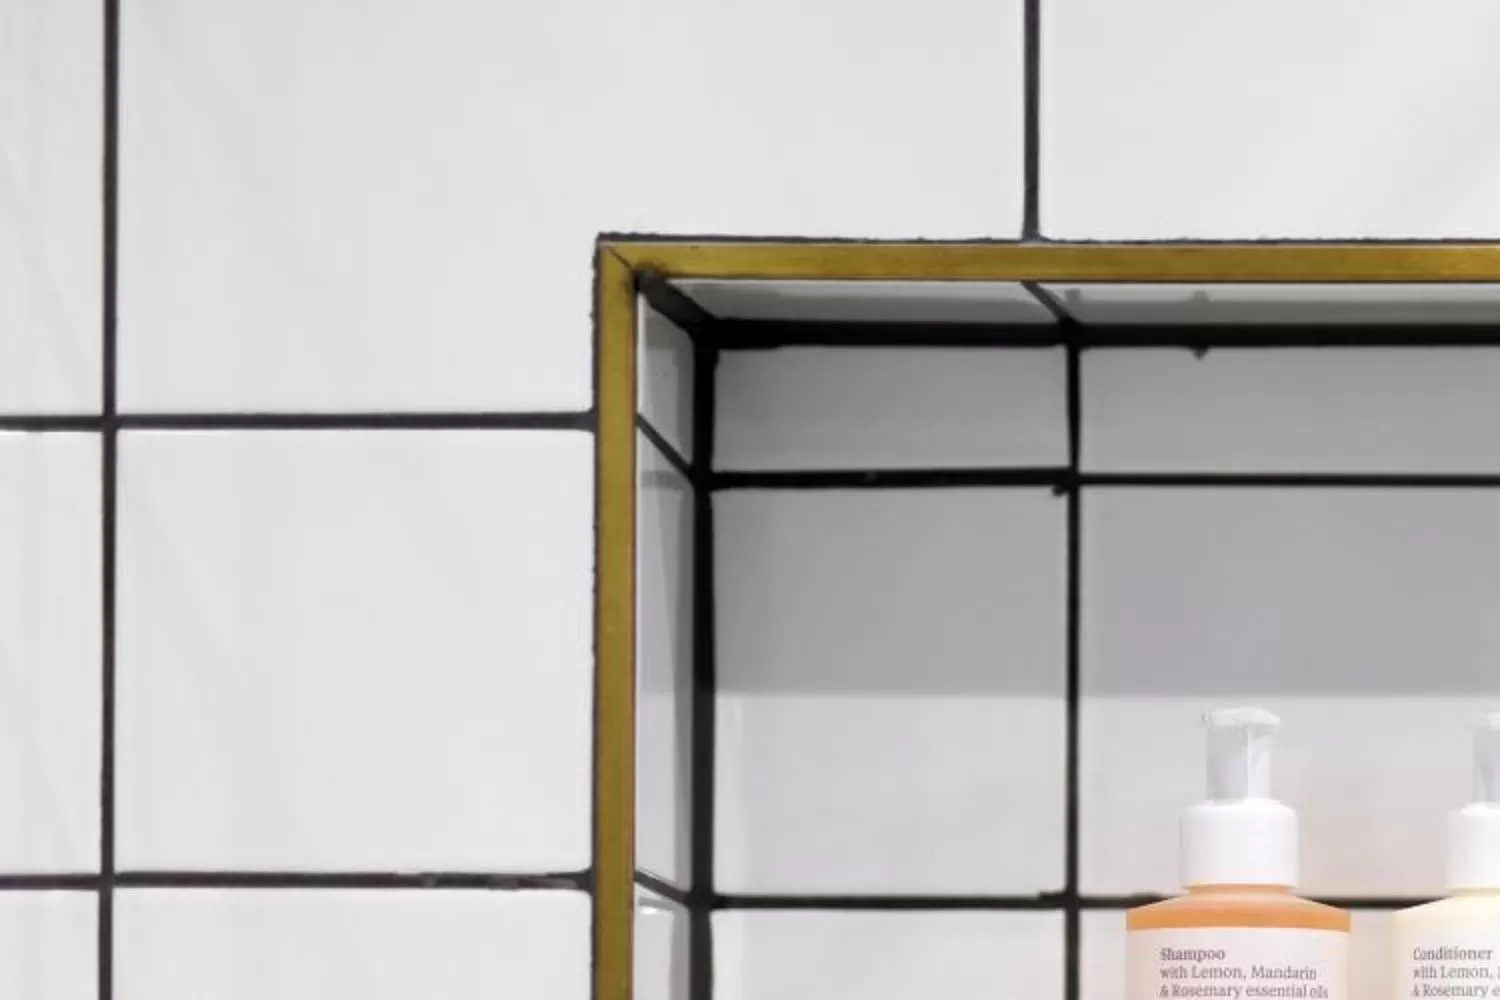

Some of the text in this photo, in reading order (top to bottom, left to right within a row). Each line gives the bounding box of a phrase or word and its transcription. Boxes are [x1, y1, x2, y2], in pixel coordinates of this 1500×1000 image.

[1160, 947, 1226, 964] Shampoo
[1413, 946, 1494, 961] Conditioner
[1159, 965, 1318, 981] with Lemon, Mandarin
[1412, 965, 1438, 979] with
[1440, 965, 1494, 980] Lemon,
[1159, 984, 1169, 998] &
[1171, 983, 1242, 1000] Rosemary
[1245, 983, 1307, 998] essential
[1411, 984, 1420, 998] &
[1423, 983, 1489, 999] Rosemary
